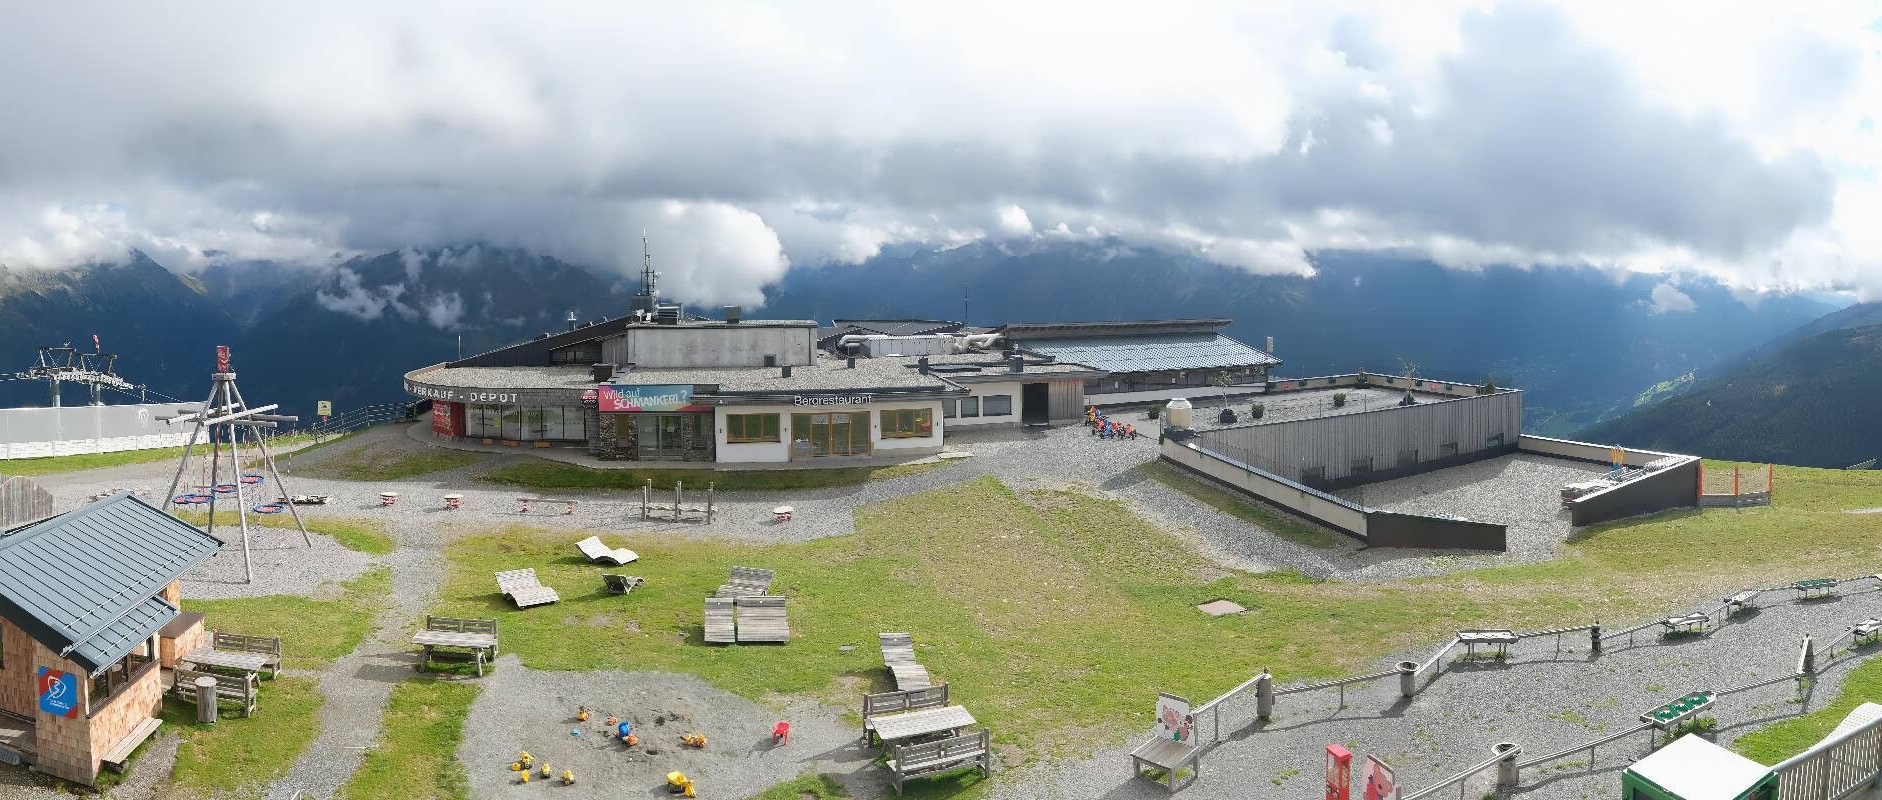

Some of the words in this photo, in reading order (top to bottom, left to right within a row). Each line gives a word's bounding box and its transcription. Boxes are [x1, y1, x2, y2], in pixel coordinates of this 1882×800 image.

[413, 385, 454, 400] VERKAUF
[470, 392, 518, 403] DEPOT
[603, 388, 624, 400] Wild
[626, 388, 641, 398] auf
[794, 394, 872, 408] Bergrestaurant
